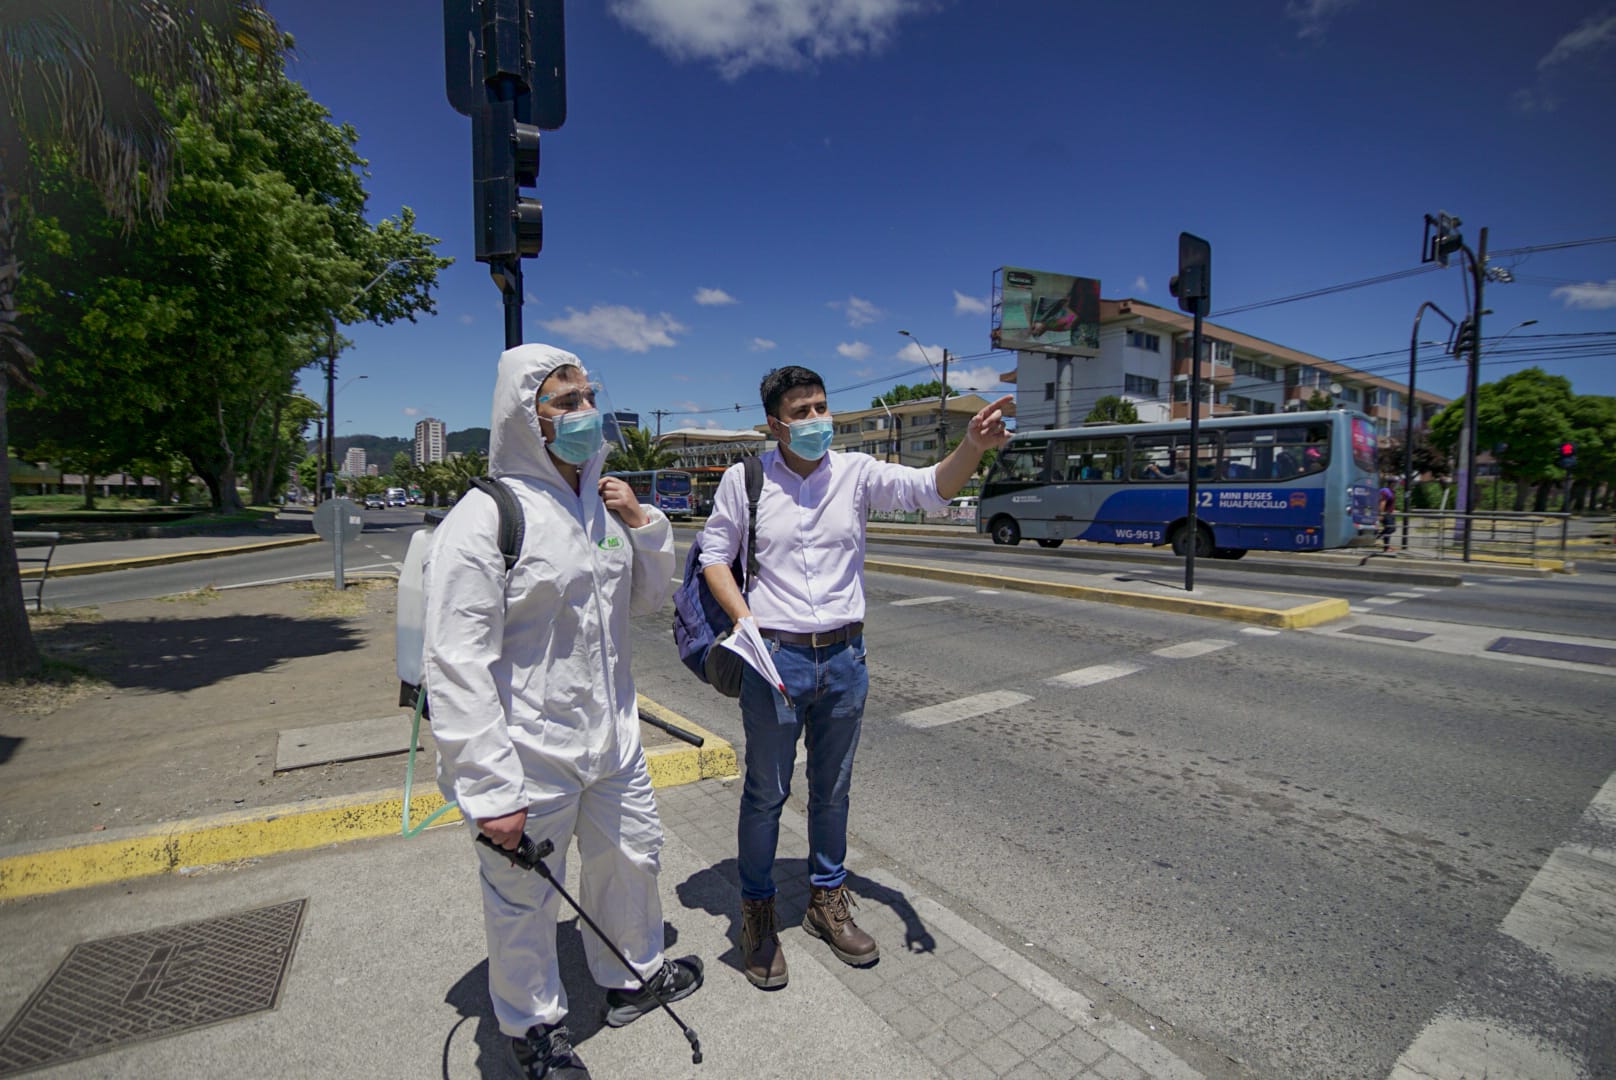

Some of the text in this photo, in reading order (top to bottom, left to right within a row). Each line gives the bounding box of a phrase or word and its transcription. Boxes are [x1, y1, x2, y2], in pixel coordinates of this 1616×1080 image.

[1219, 491, 1273, 501] MINI BUSES
[1219, 500, 1287, 509] HUALPENCILLO
[1115, 529, 1161, 540] WG-9613
[1295, 534, 1319, 545] 011
